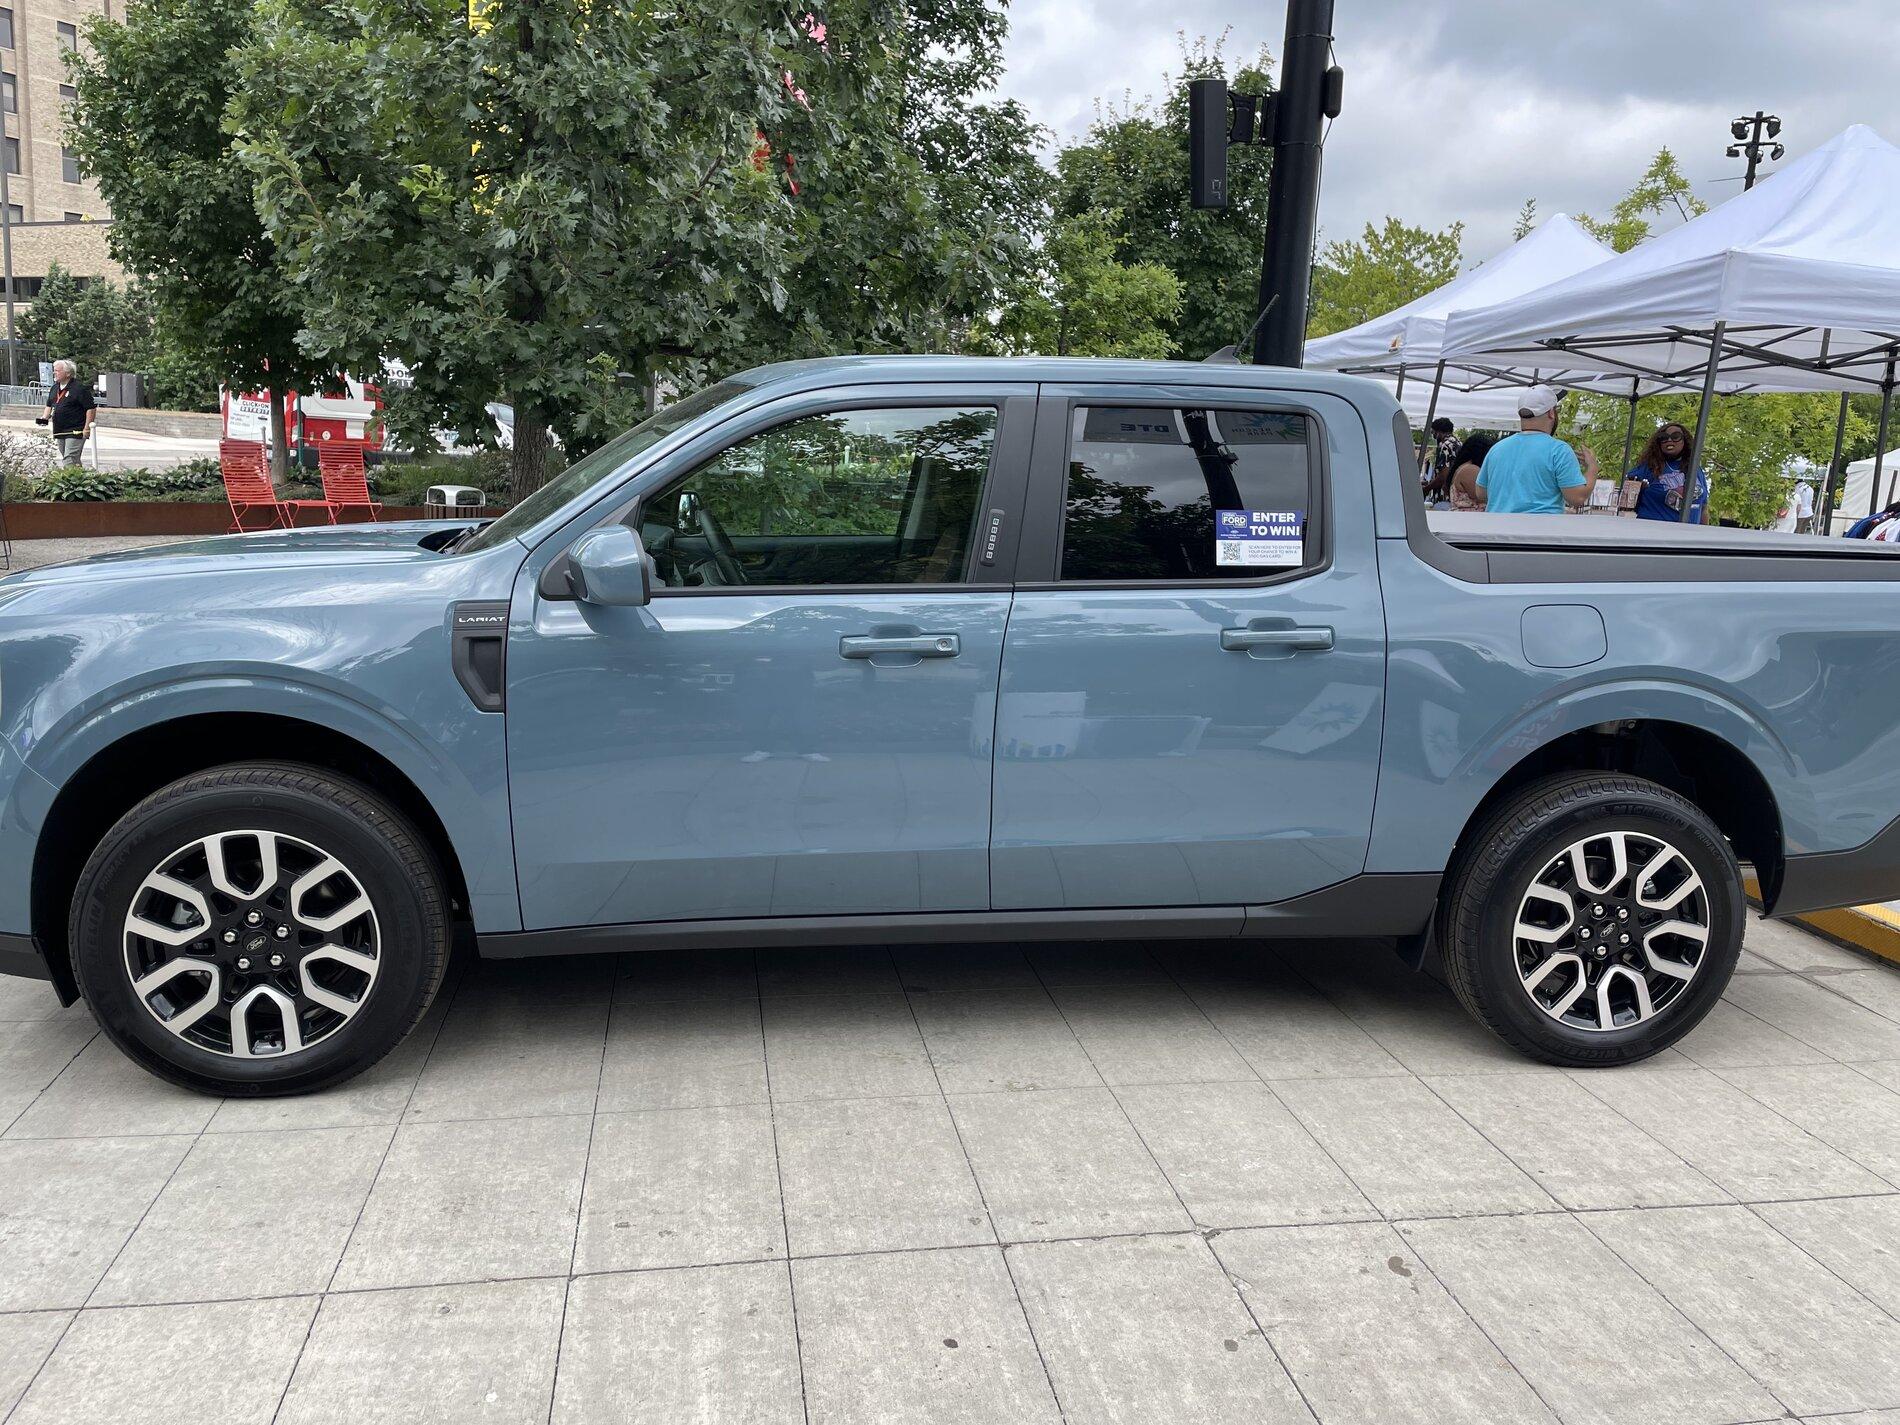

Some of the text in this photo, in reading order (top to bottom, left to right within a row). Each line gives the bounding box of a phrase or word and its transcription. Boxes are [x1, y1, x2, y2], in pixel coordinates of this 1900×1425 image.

[1223, 516, 1246, 524] FORD
[1252, 512, 1296, 523] ENTER
[1249, 525, 1268, 536] TO
[458, 615, 506, 623] LARIAT
